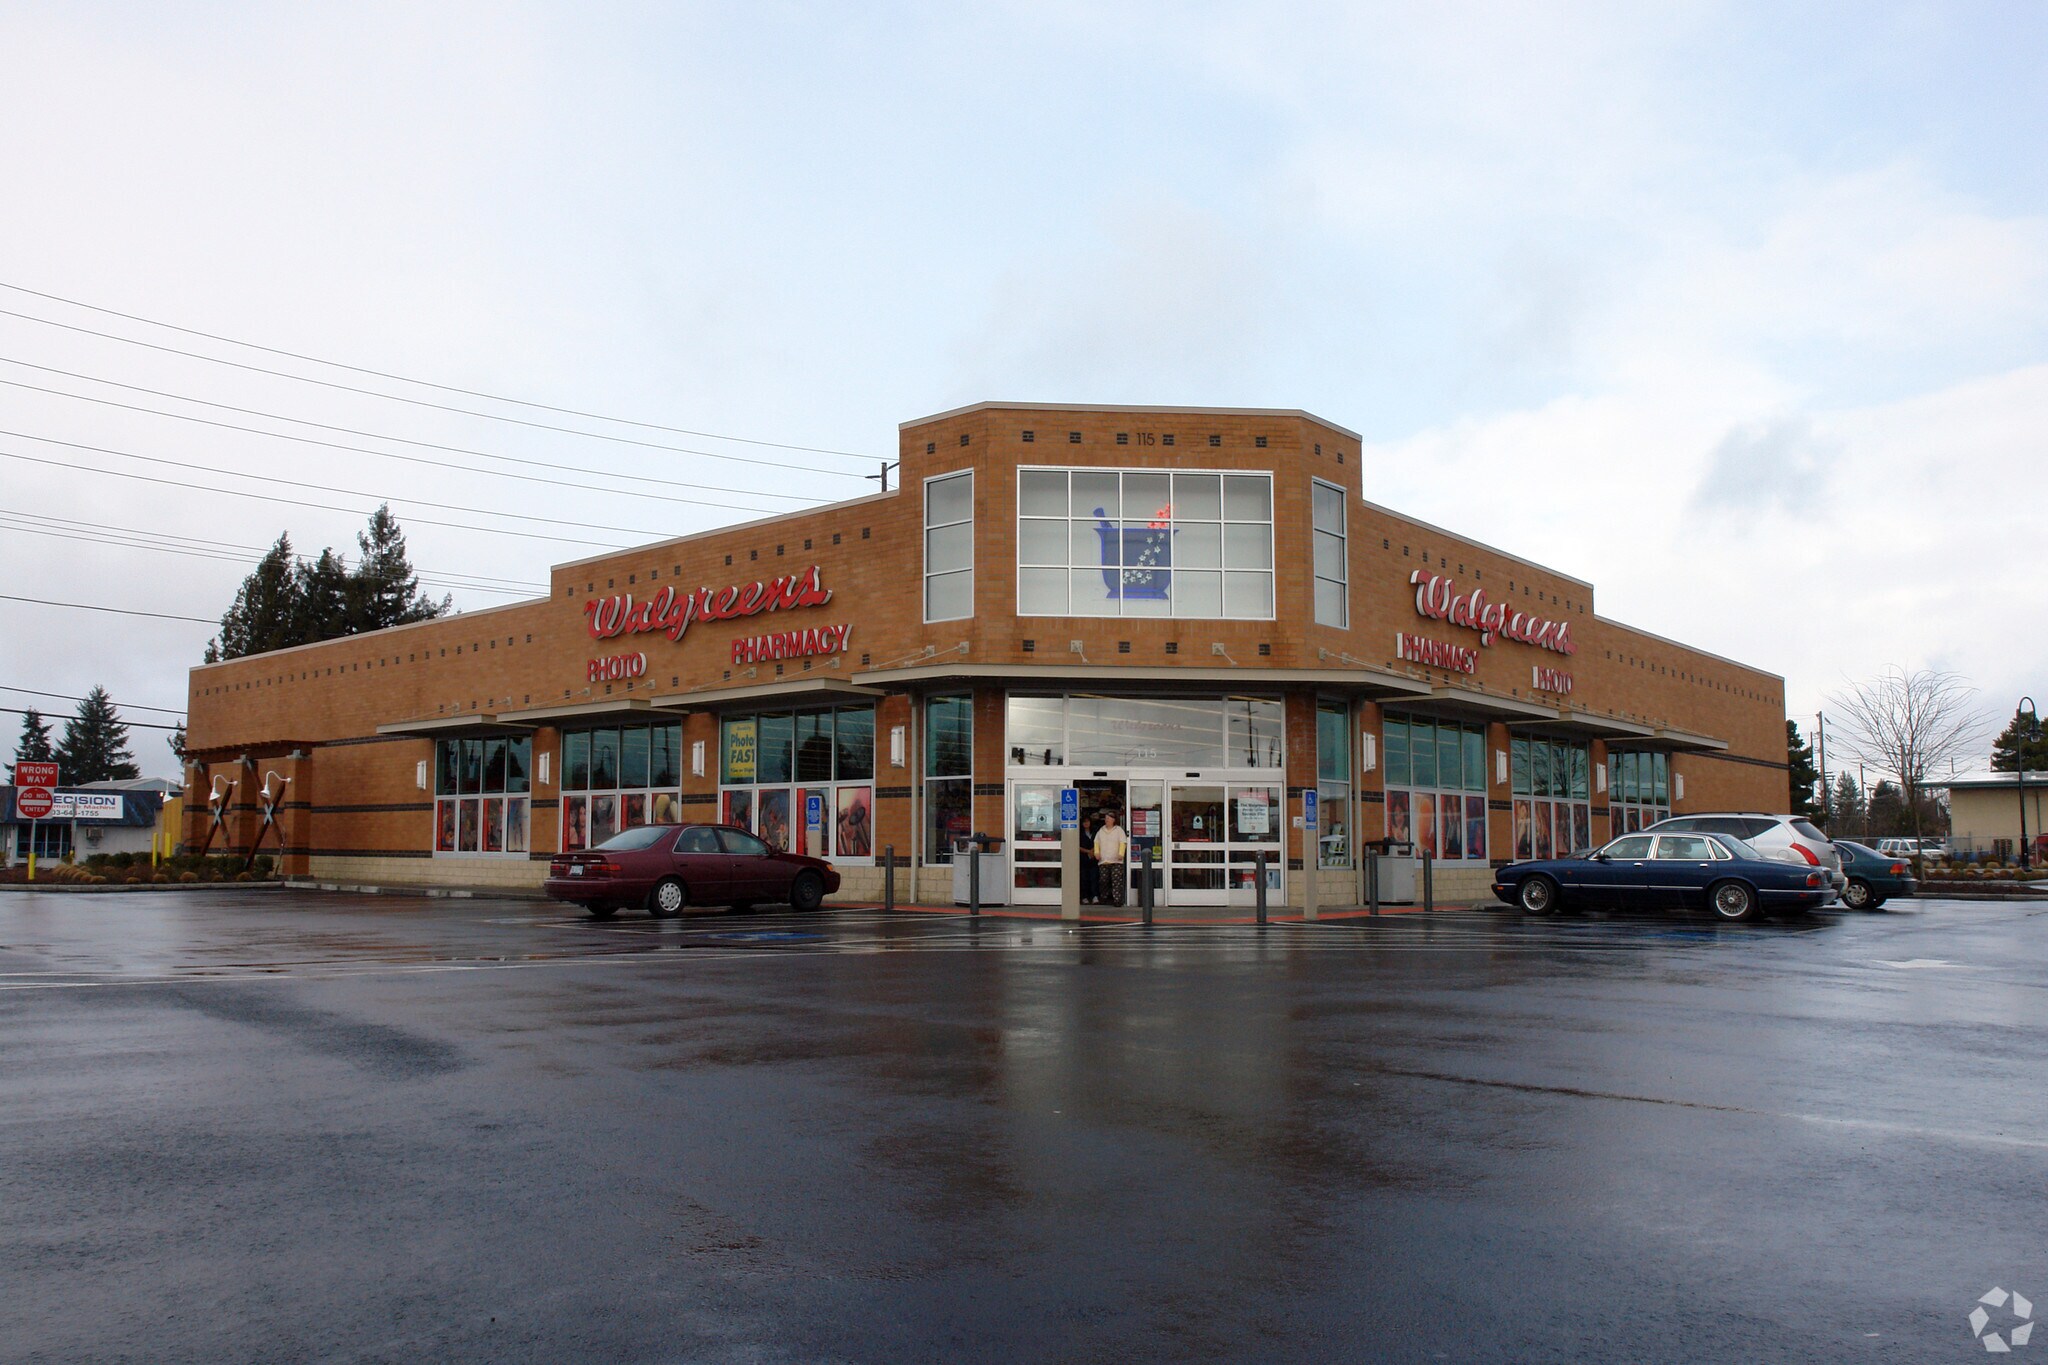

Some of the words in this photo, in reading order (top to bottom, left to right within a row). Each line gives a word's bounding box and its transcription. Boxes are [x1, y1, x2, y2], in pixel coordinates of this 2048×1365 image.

[1136, 433, 1155, 446] 115
[584, 565, 832, 642] Walgreens
[1410, 569, 1578, 656] Walgreens
[731, 624, 852, 665] PHARMACY
[1396, 632, 1480, 675] PHARMACY
[587, 652, 647, 682] PHOTO
[1532, 666, 1574, 694] PHOTO
[731, 733, 755, 747] Photo
[21, 766, 54, 774] WRONG
[26, 775, 47, 784] WAY
